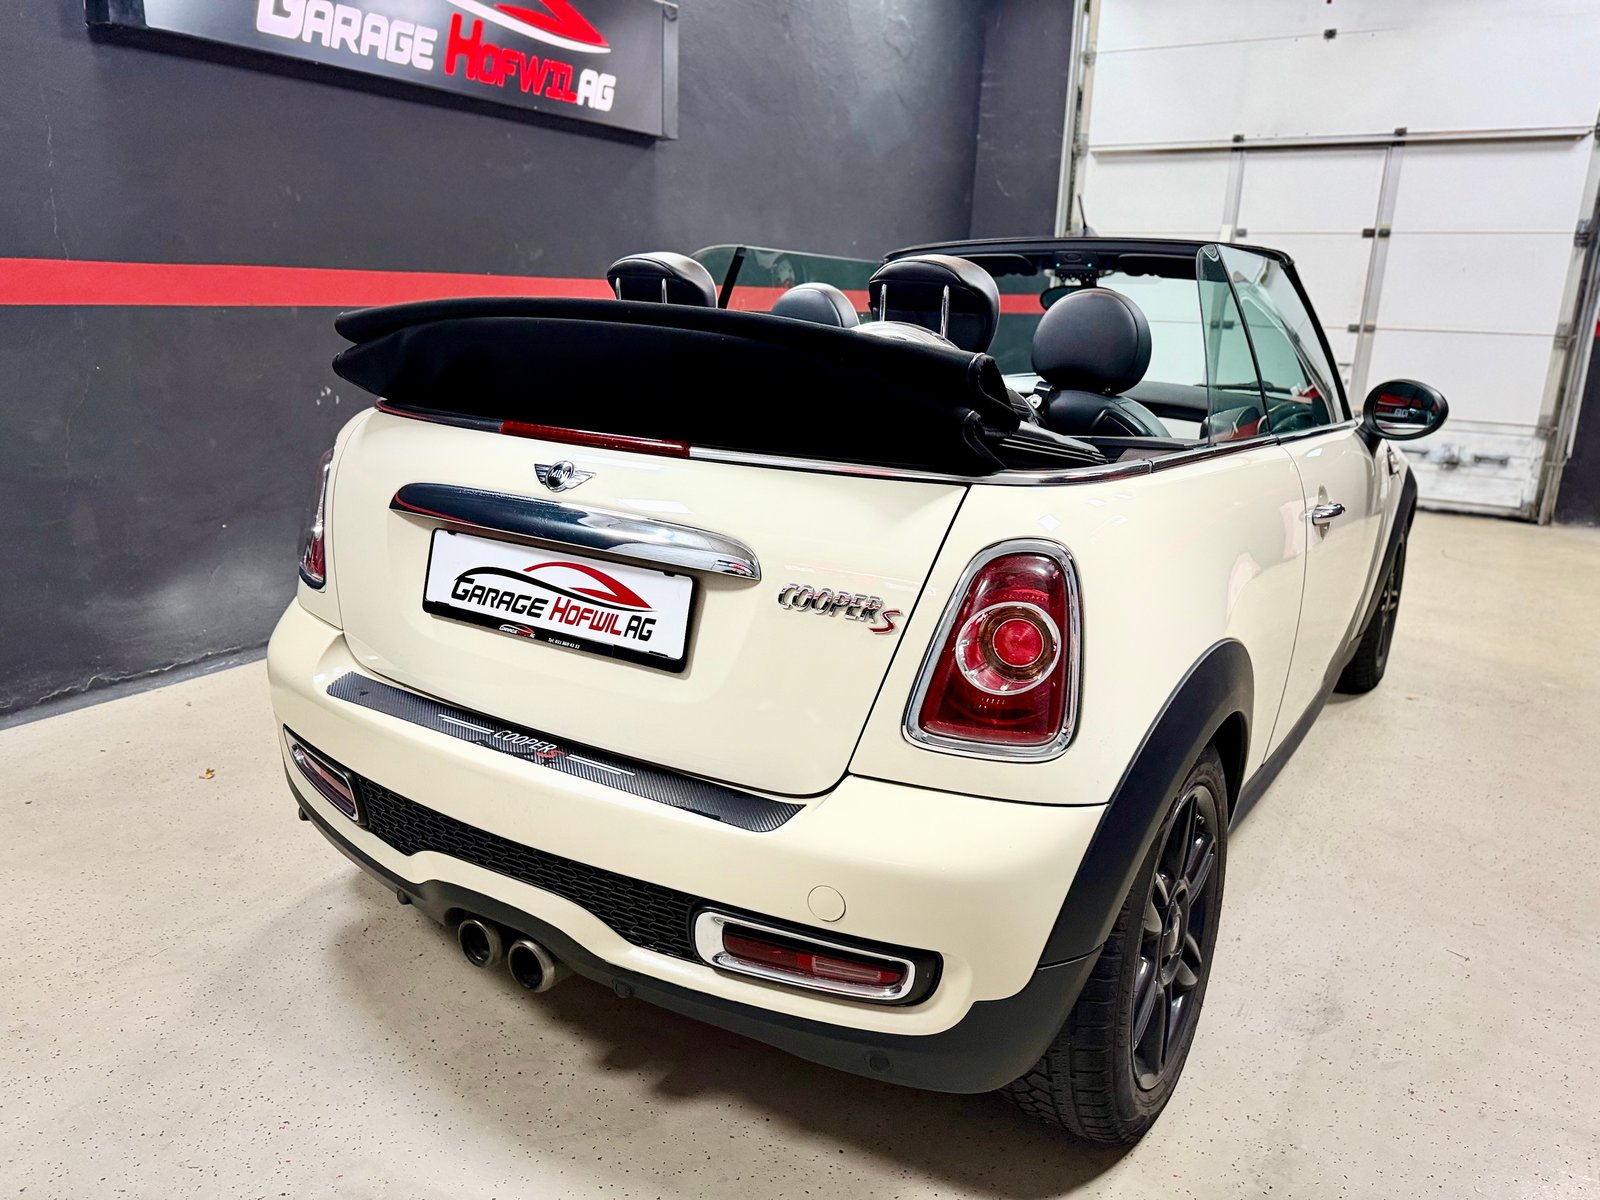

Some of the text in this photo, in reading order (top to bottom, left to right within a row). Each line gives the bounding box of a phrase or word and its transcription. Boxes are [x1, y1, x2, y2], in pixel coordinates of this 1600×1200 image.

[444, 13, 577, 104] HOFWIL
[577, 68, 616, 112] AG
[548, 468, 572, 480] MINI
[451, 577, 657, 641] GARAGE HOFWIL AG
[778, 583, 901, 634] COOPER S
[494, 730, 558, 754] COOPER
